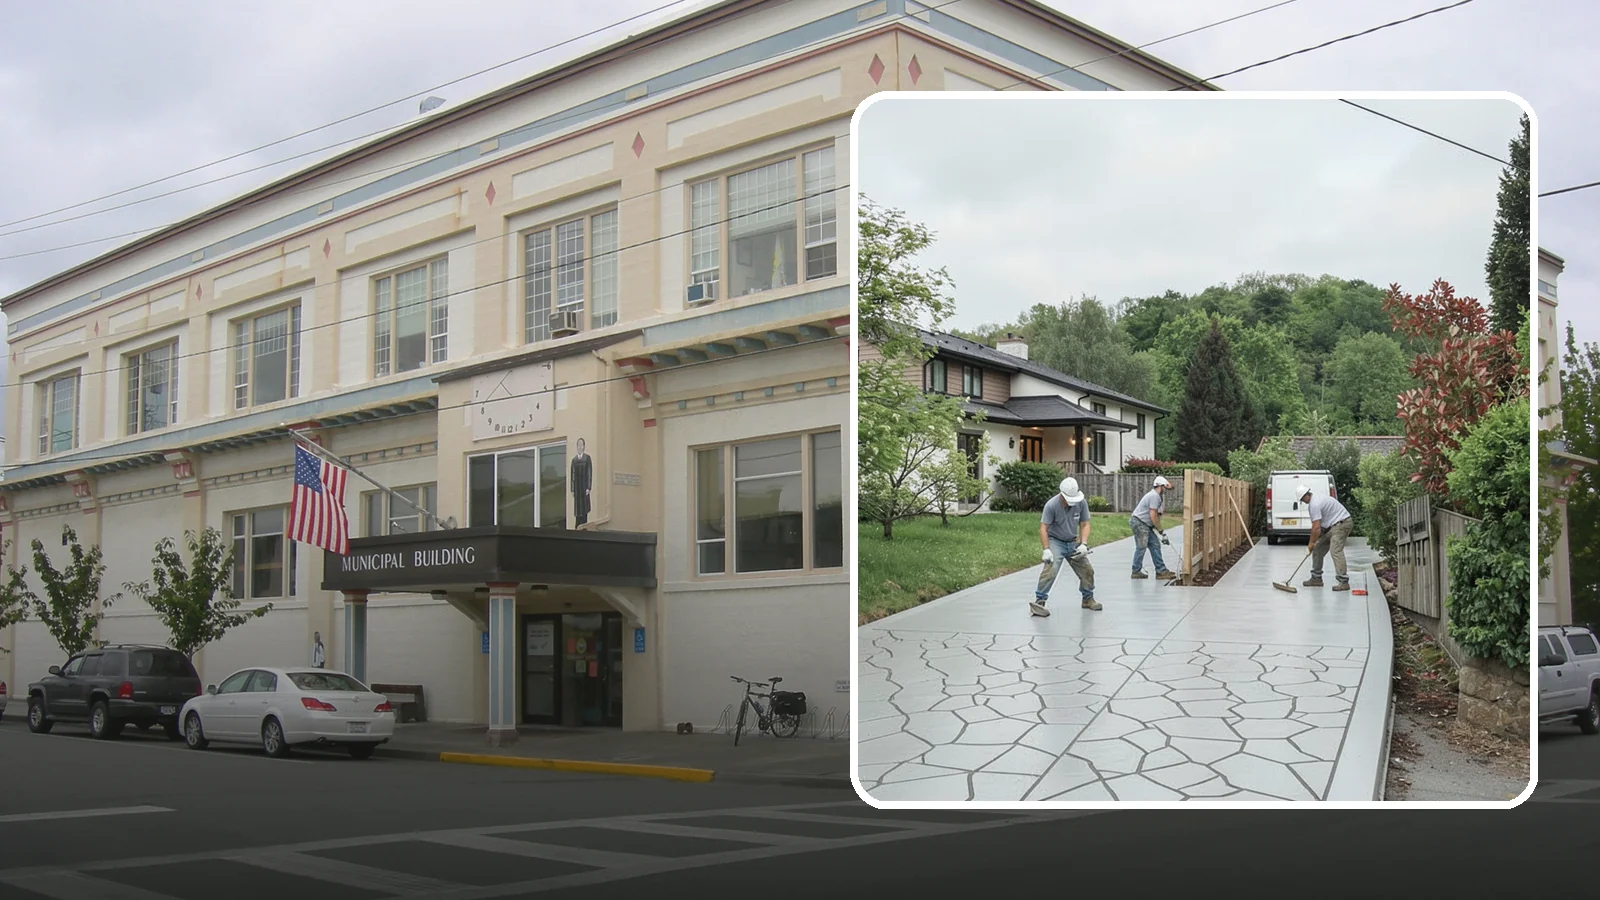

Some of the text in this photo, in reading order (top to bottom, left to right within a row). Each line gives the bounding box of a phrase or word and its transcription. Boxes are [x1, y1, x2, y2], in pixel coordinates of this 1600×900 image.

[488, 418, 492, 426] 9
[529, 414, 532, 422] 3
[494, 424, 500, 432] 10
[521, 420, 525, 428] 2
[342, 546, 475, 572] MUNICIPAL BUILDING
